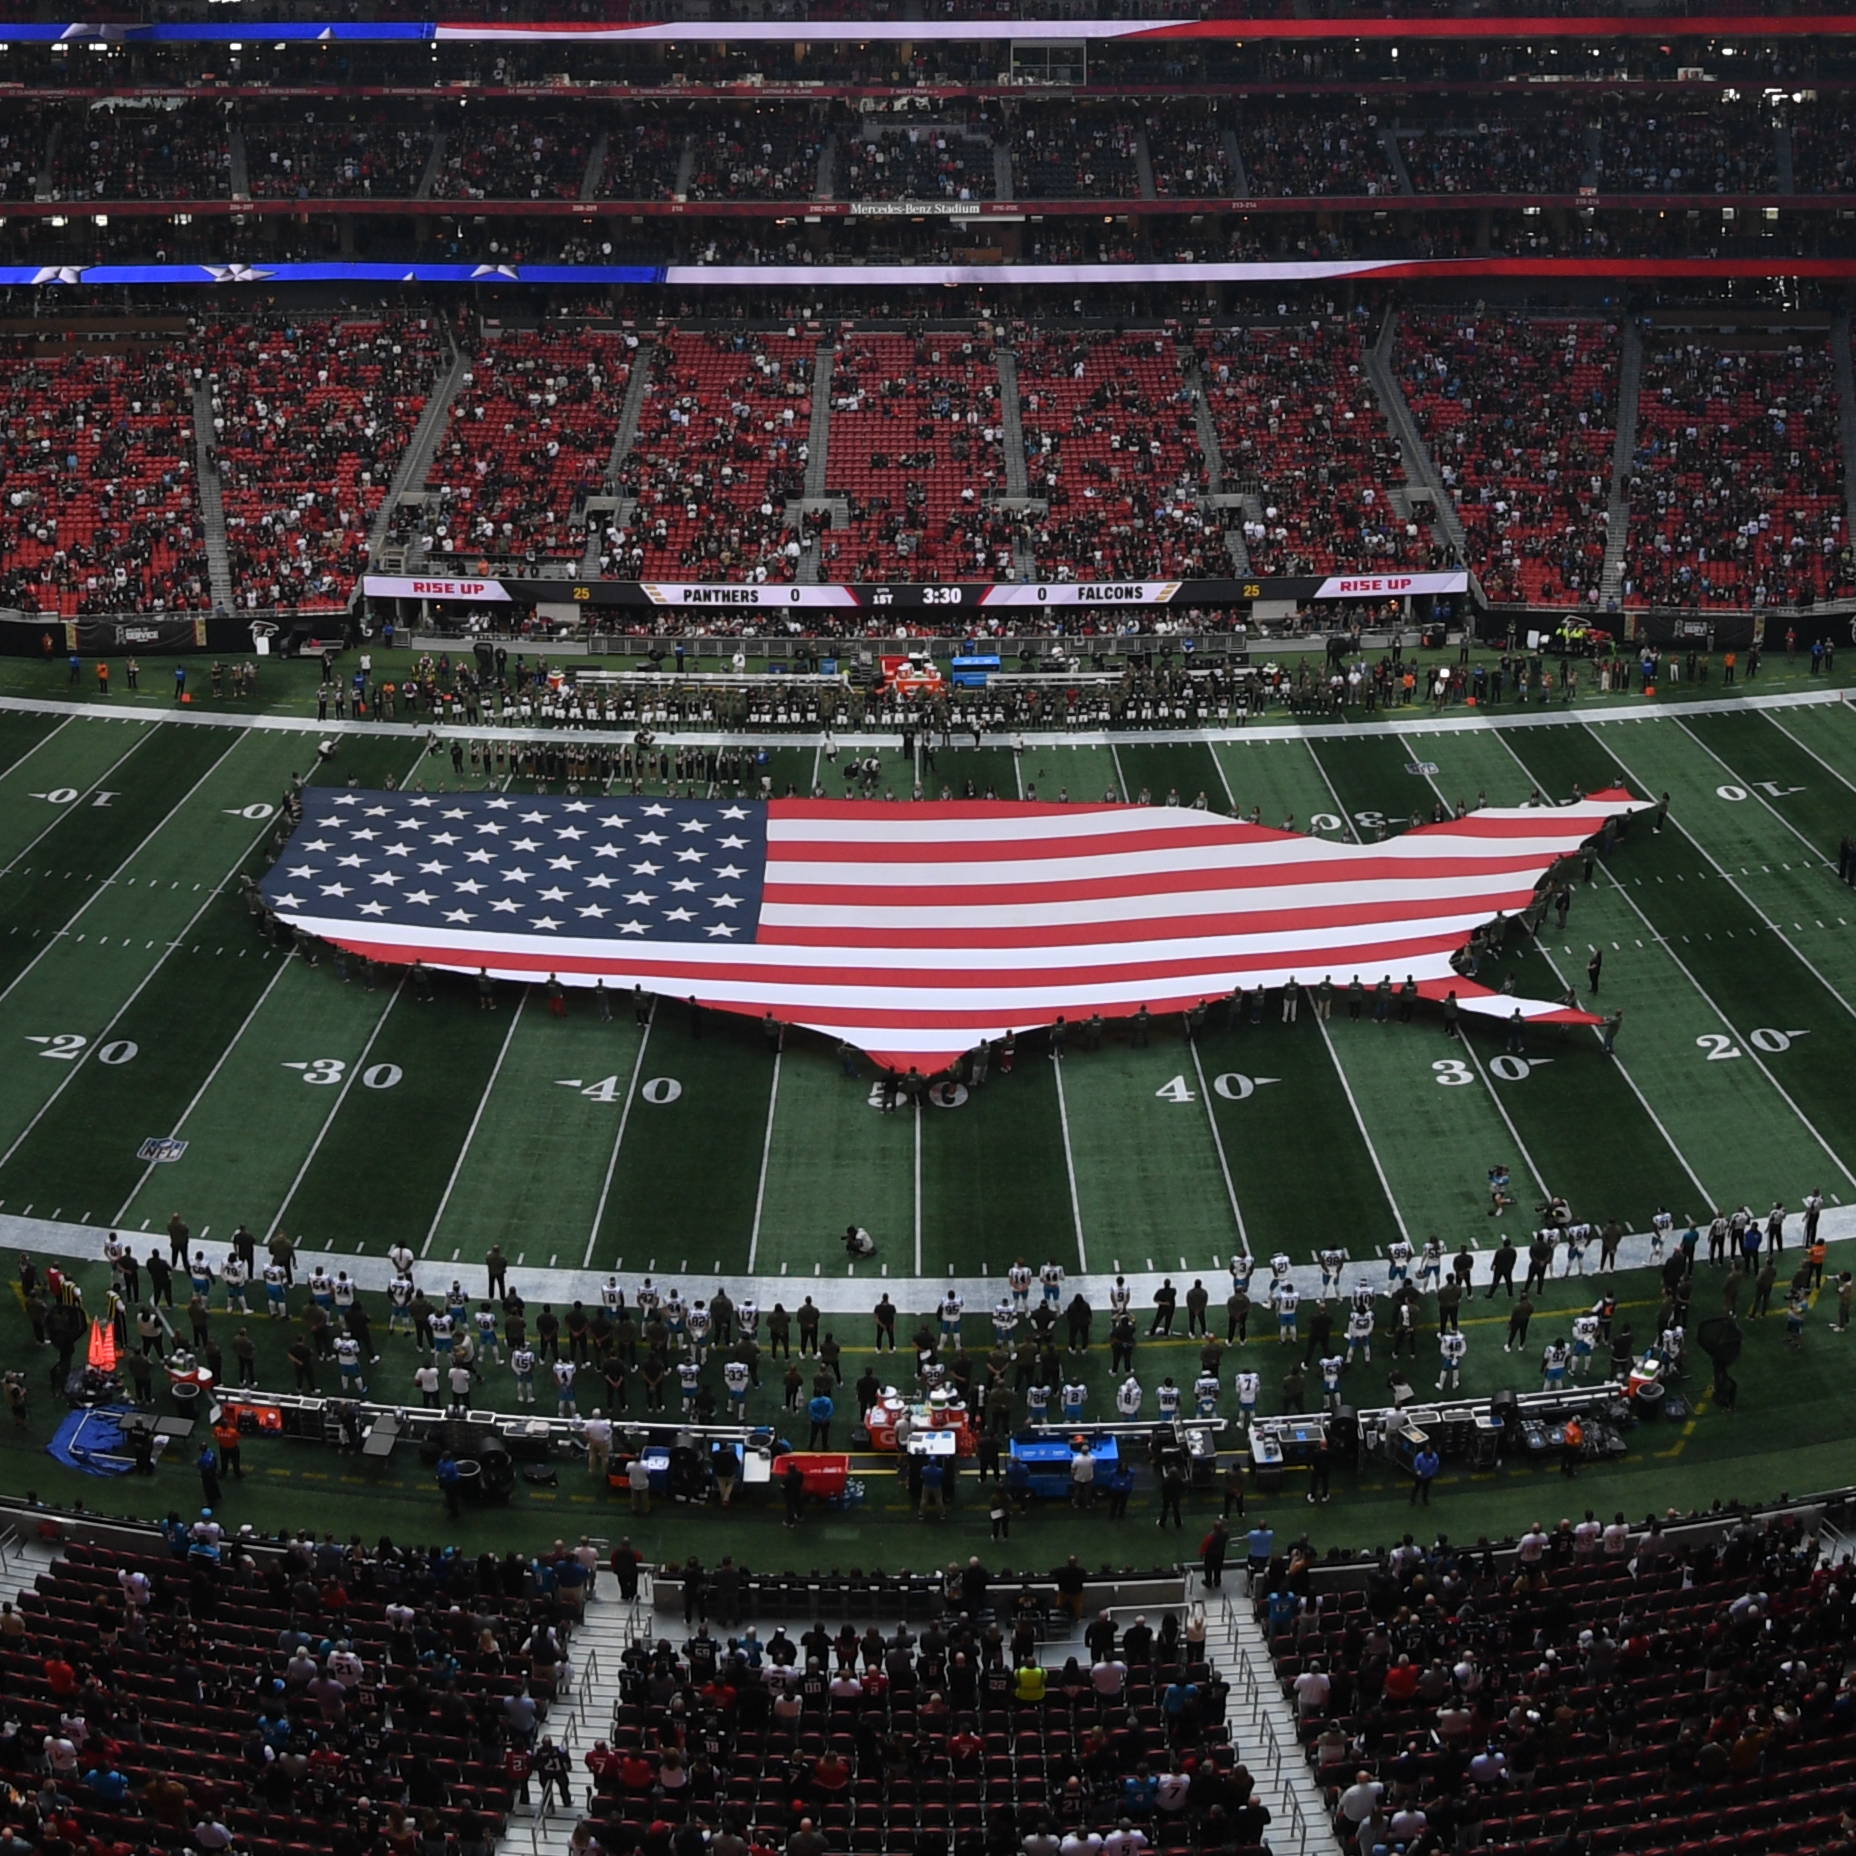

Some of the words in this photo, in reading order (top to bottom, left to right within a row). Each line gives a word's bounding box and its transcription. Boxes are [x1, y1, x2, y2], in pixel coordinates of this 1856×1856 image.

[850, 203, 932, 215] Mercedes-Benz
[934, 203, 980, 215] Stadium
[412, 581, 455, 594] RISE
[460, 582, 485, 595] UP
[1243, 584, 1260, 597] 25
[1339, 580, 1382, 592] RISE
[1387, 578, 1412, 590] UP
[573, 587, 590, 600] 25
[683, 588, 758, 603] PANTHERS
[790, 588, 800, 602] 0
[872, 594, 893, 605] 1ST
[922, 587, 962, 604] 3:30
[1037, 587, 1047, 601] 0
[1077, 585, 1143, 601] FALCONS
[38, 1033, 139, 1065] 20
[1694, 1027, 1792, 1062] 20
[302, 1058, 403, 1089] 30
[1431, 1053, 1532, 1086] 30
[581, 1075, 683, 1104] 40
[1154, 1072, 1255, 1103] 40
[144, 1146, 175, 1160] NFL
[335, 1663, 353, 1676] 21
